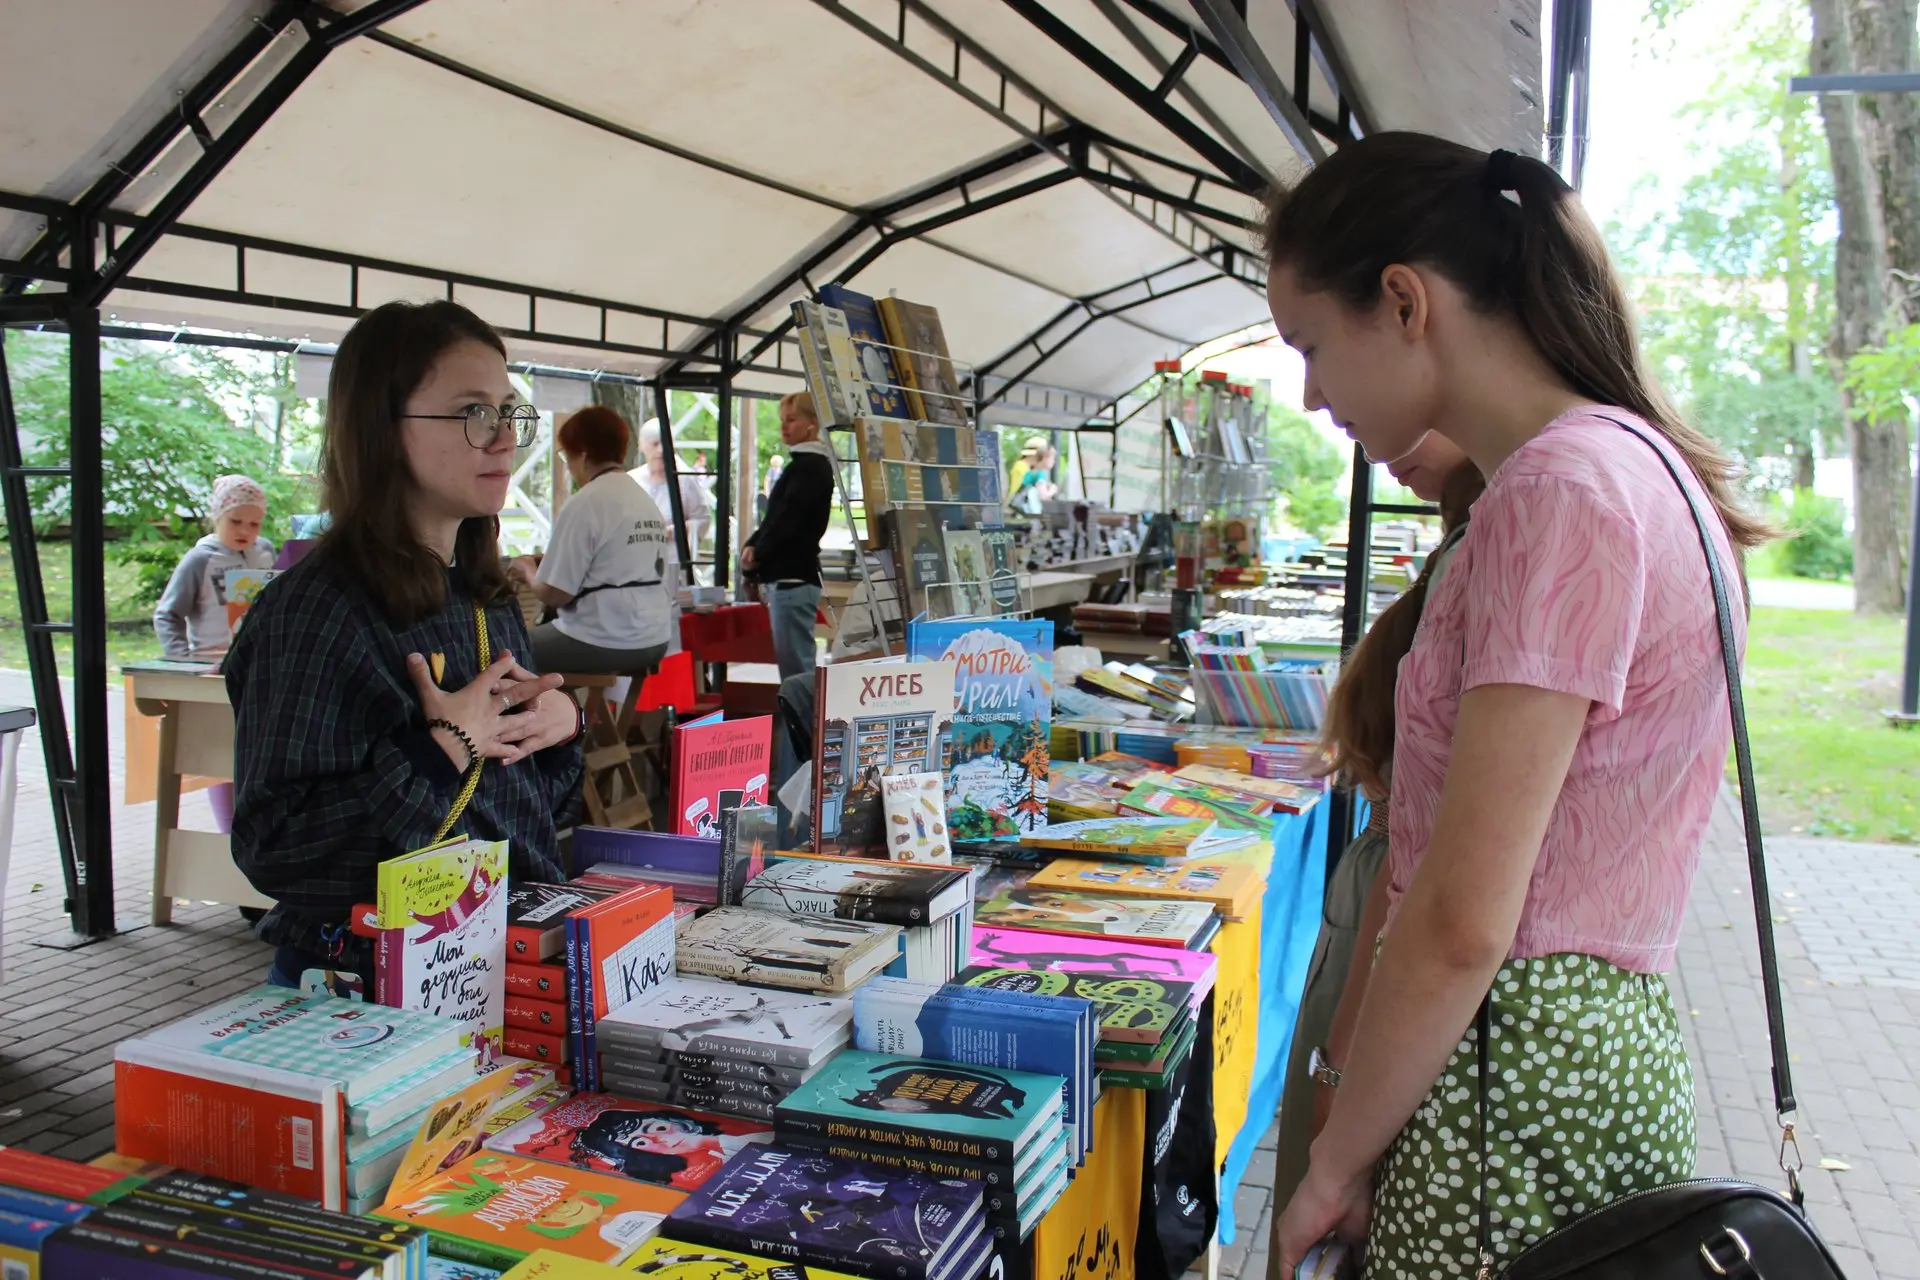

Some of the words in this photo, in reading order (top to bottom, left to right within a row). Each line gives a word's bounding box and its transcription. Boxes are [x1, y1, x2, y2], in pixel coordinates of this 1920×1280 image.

[858, 672, 924, 706] ХЛЕБ
[690, 745, 729, 773] ЕВГЕНИЙ
[729, 743, 764, 766] ОНЕГИН
[887, 777, 917, 796] ХЛЕБ
[795, 900, 827, 914] ПАКС
[426, 930, 467, 970] Мой
[420, 954, 493, 1008] дедушка
[457, 974, 484, 1005] был
[660, 995, 694, 1009] Кот
[210, 996, 310, 1038] ВАФЕЛЬНОЕ
[248, 1007, 312, 1035] СЕРДЦЕ
[828, 1122, 857, 1138] ЛЮДЕЙ
[860, 1128, 867, 1138] И
[869, 1129, 900, 1144] УЛИТОК
[902, 1131, 926, 1148] ЧАЕК,
[930, 1136, 960, 1152] КОТОВ,
[962, 1142, 980, 1156] ПРО
[963, 1168, 981, 1180] ПРО
